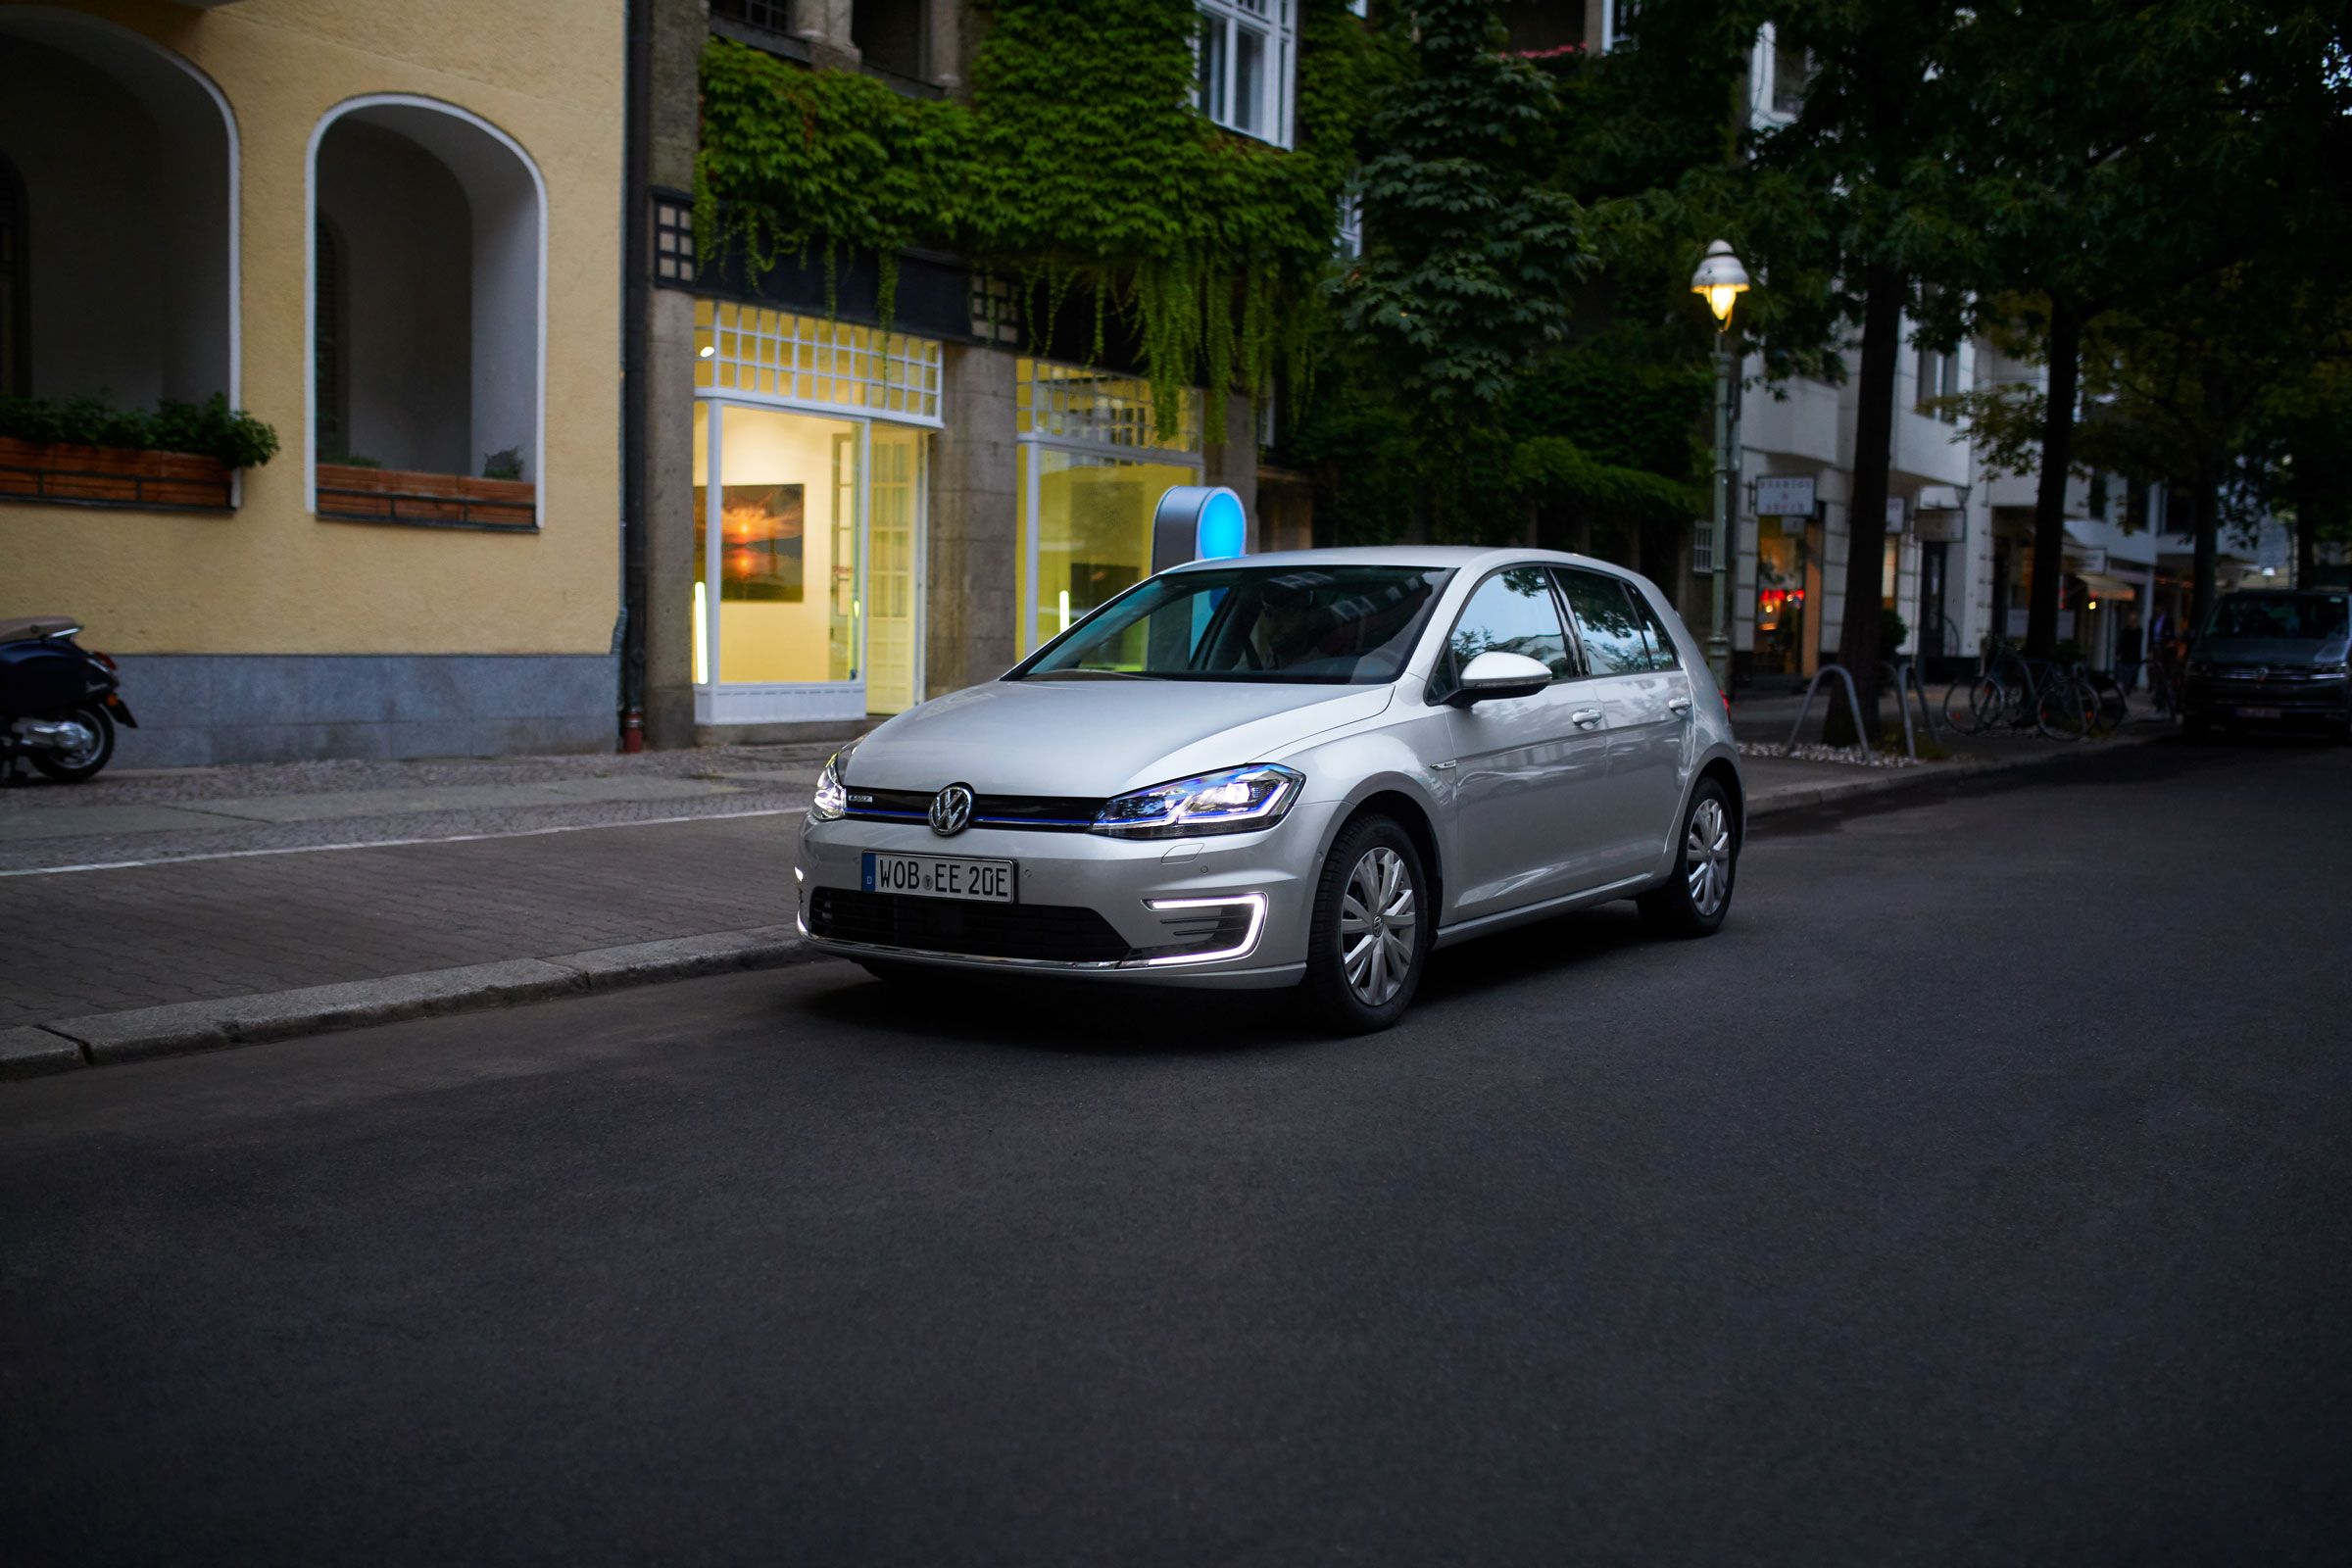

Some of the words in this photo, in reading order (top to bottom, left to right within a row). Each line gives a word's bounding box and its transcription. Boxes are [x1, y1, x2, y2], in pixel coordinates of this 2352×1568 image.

[866, 876, 873, 885] D
[880, 859, 920, 889] WOB
[935, 863, 961, 894] EE
[968, 866, 1008, 897] 20E
